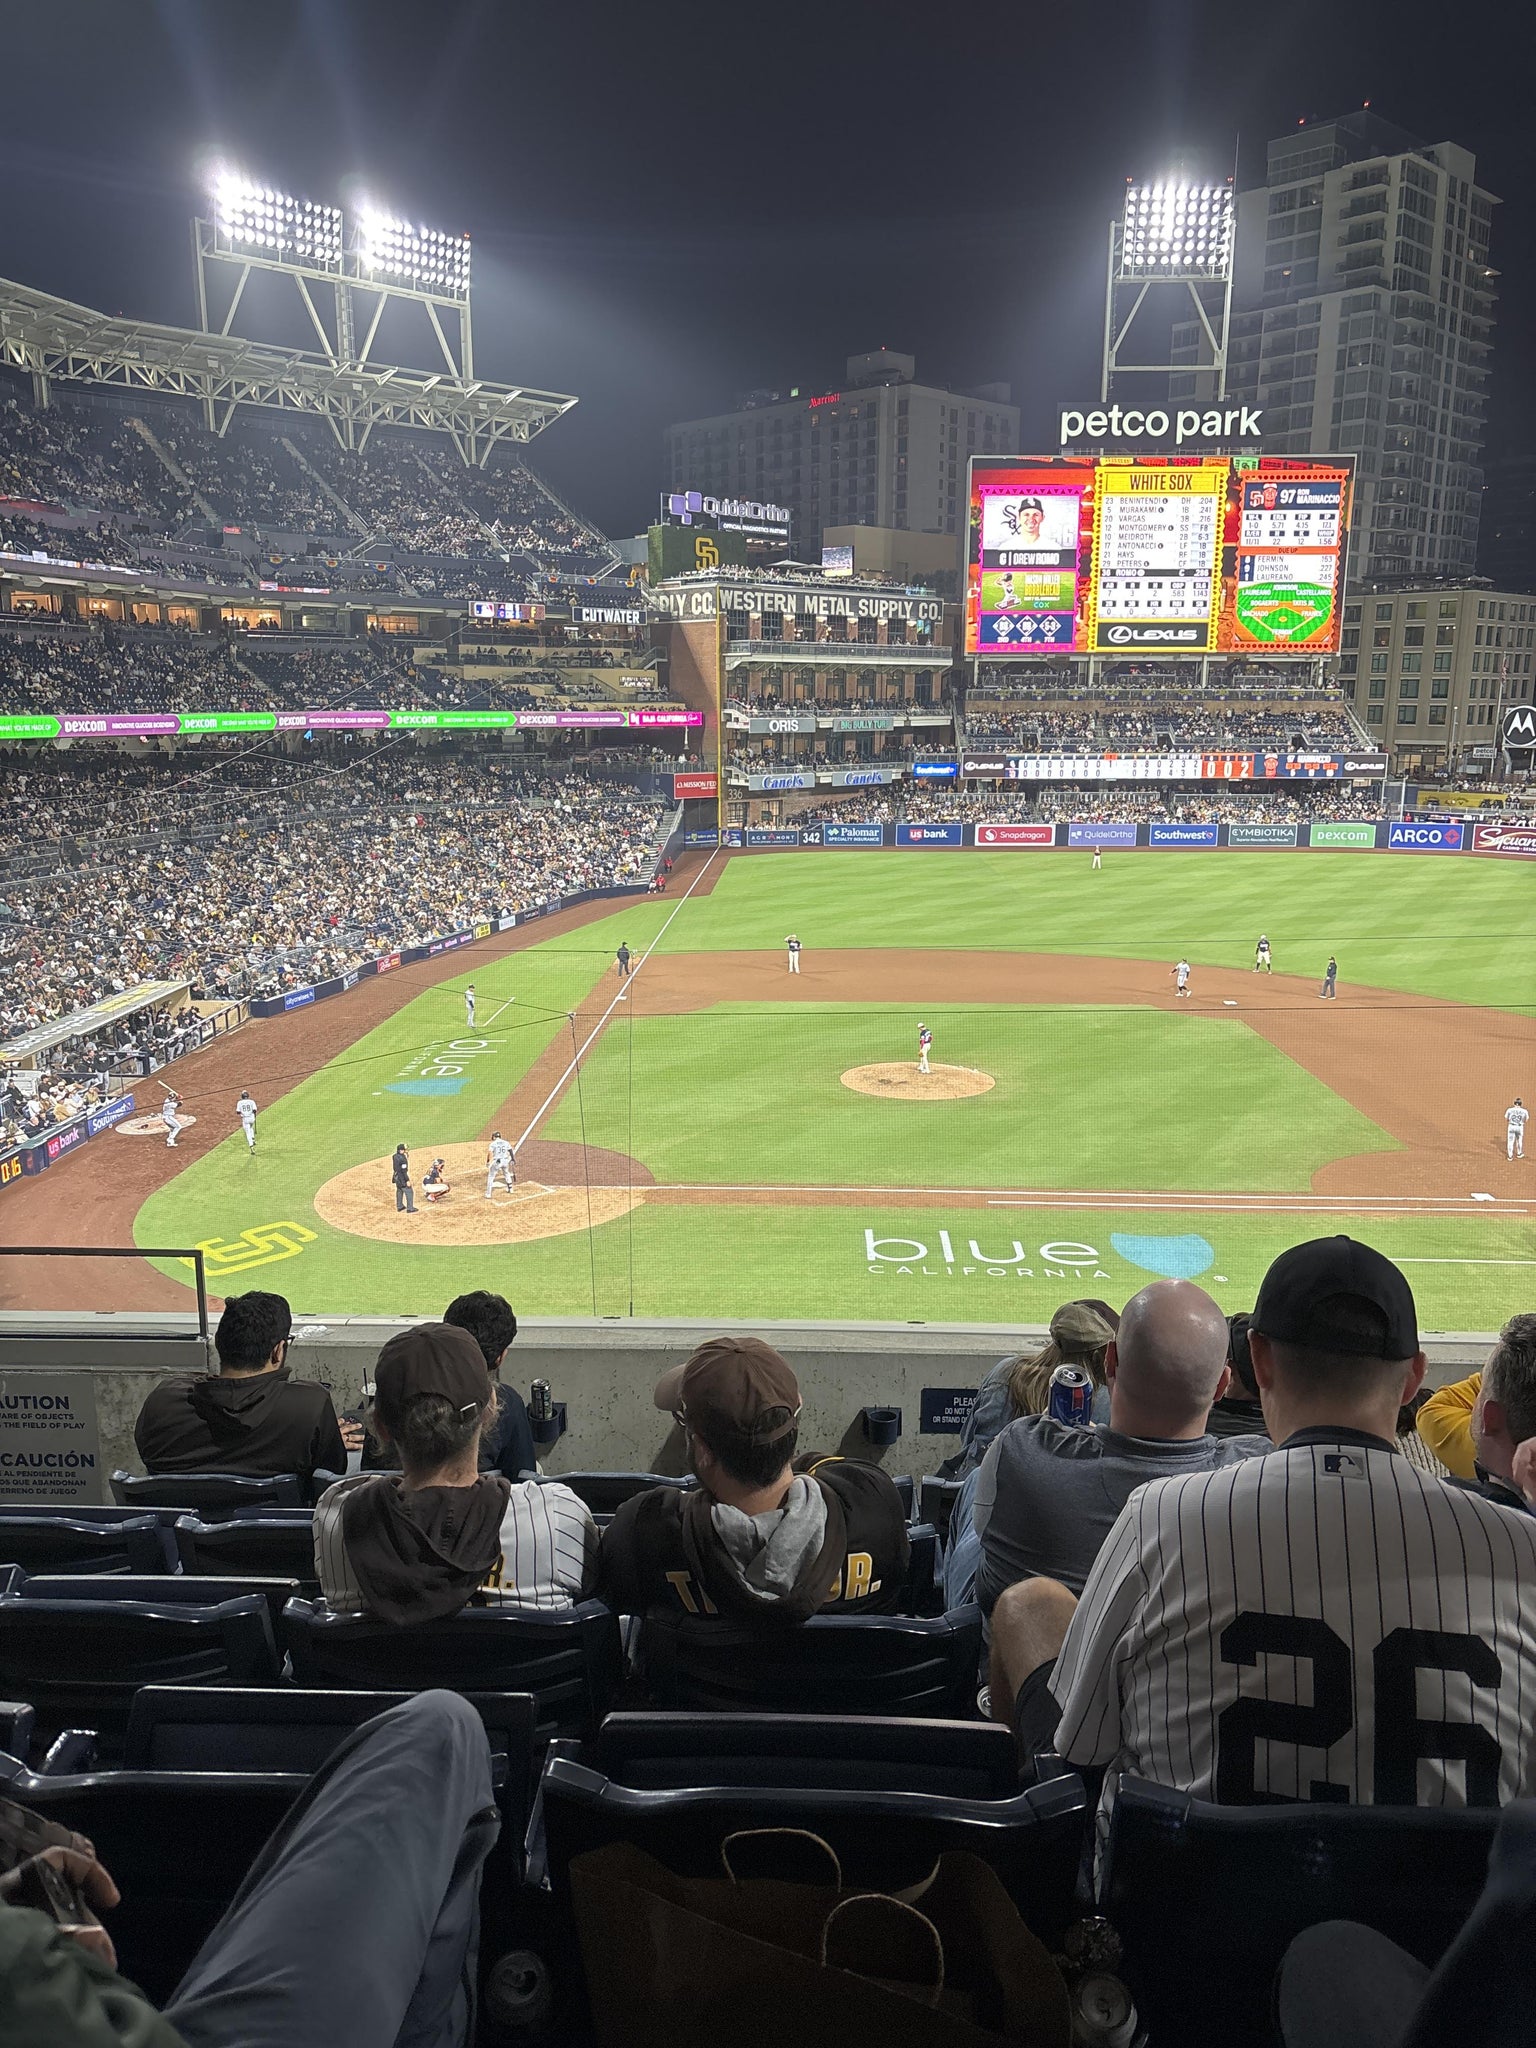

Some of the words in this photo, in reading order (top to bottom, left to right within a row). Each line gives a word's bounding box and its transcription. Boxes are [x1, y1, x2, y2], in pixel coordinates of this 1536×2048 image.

[1060, 404, 1170, 445] petco
[1175, 406, 1264, 445] park
[1130, 474, 1166, 490] WHITE
[1169, 474, 1193, 490] SOX
[1280, 489, 1296, 504] 97
[1297, 495, 1340, 504] MARINACCIO
[703, 496, 790, 522] QuidelOrtho
[1013, 553, 1035, 565] DREW
[1036, 553, 1060, 565] ROMO
[691, 592, 718, 616] CO.
[718, 590, 797, 613] WESTERN
[804, 595, 854, 617] METAL
[858, 600, 914, 620] SUPPLY
[918, 602, 942, 621] CO.
[582, 608, 640, 624] CUTWATER
[1133, 630, 1198, 640] LEXUS
[769, 720, 799, 732] ORIS
[841, 720, 852, 729] BIG
[1207, 762, 1215, 777] 0
[1224, 762, 1232, 777] 0
[1241, 762, 1249, 777] 2
[728, 788, 743, 800] 336
[802, 832, 820, 843] 342
[841, 828, 879, 836] Palomar
[924, 829, 948, 838] bank
[1000, 831, 1046, 841] Snapdragon
[1084, 830, 1133, 839] QuidelOrtho
[1154, 830, 1206, 840] Southwest
[1232, 829, 1294, 837] CYMBIOTIKA
[1392, 829, 1442, 843] ARCO
[1479, 828, 1536, 850] Sycuan
[420, 1040, 507, 1076] blue
[1511, 1115, 1522, 1123] 29
[48, 1141, 59, 1155] us
[60, 1128, 79, 1149] bank
[864, 1228, 1099, 1266] blue
[868, 1264, 1111, 1279] CALIFORNIA
[0, 1450, 95, 1467] CAUCIÓN
[1217, 1610, 1502, 1807] 26
